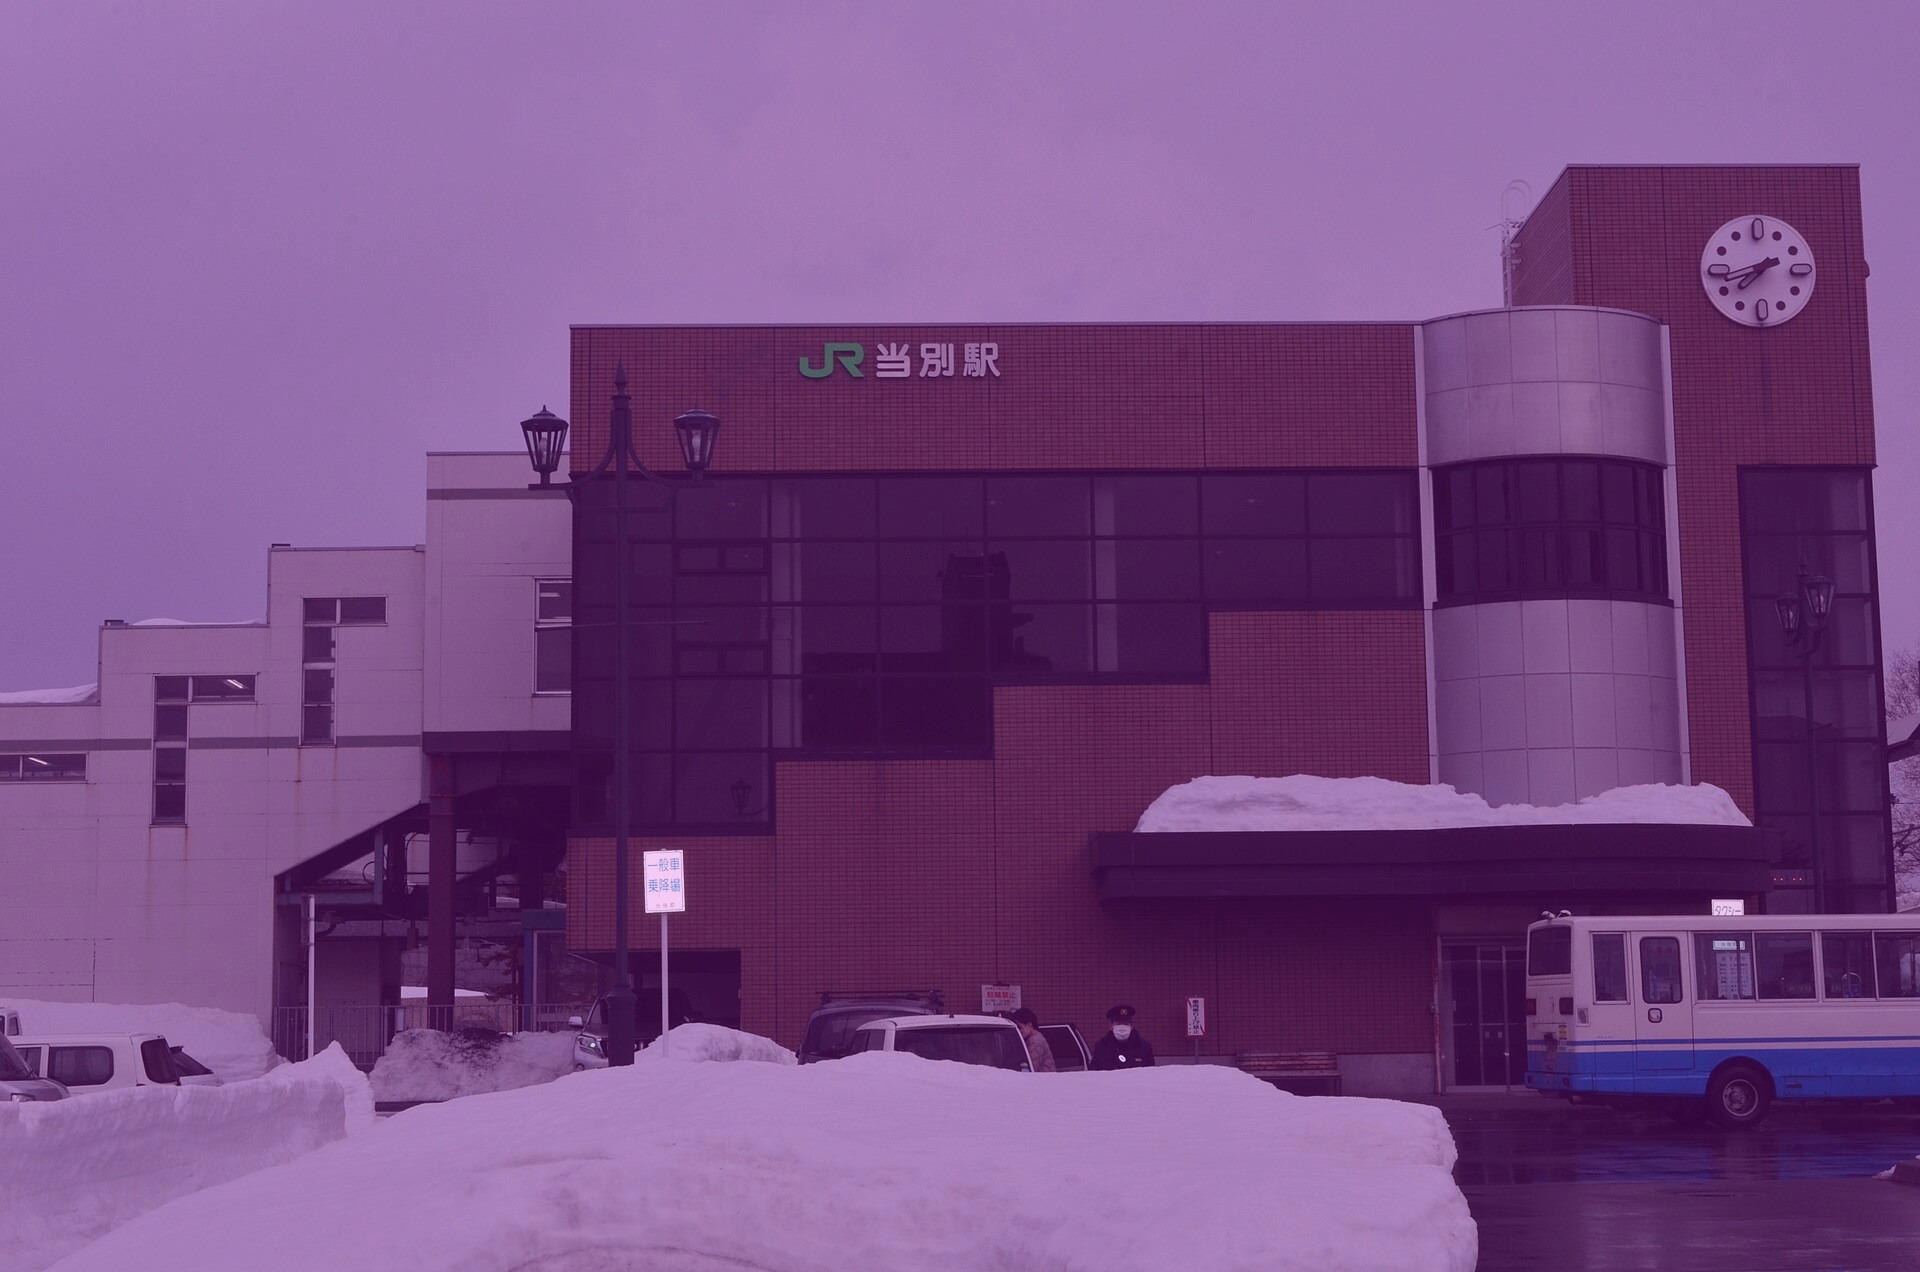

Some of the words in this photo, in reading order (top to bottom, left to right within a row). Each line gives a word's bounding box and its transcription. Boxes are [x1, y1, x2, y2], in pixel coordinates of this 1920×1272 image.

[799, 342, 864, 378] JR
[876, 342, 1001, 378] 当別駅
[647, 857, 680, 872] 一般車
[648, 878, 681, 893] 乗降場
[1714, 905, 1742, 916] タクシー
